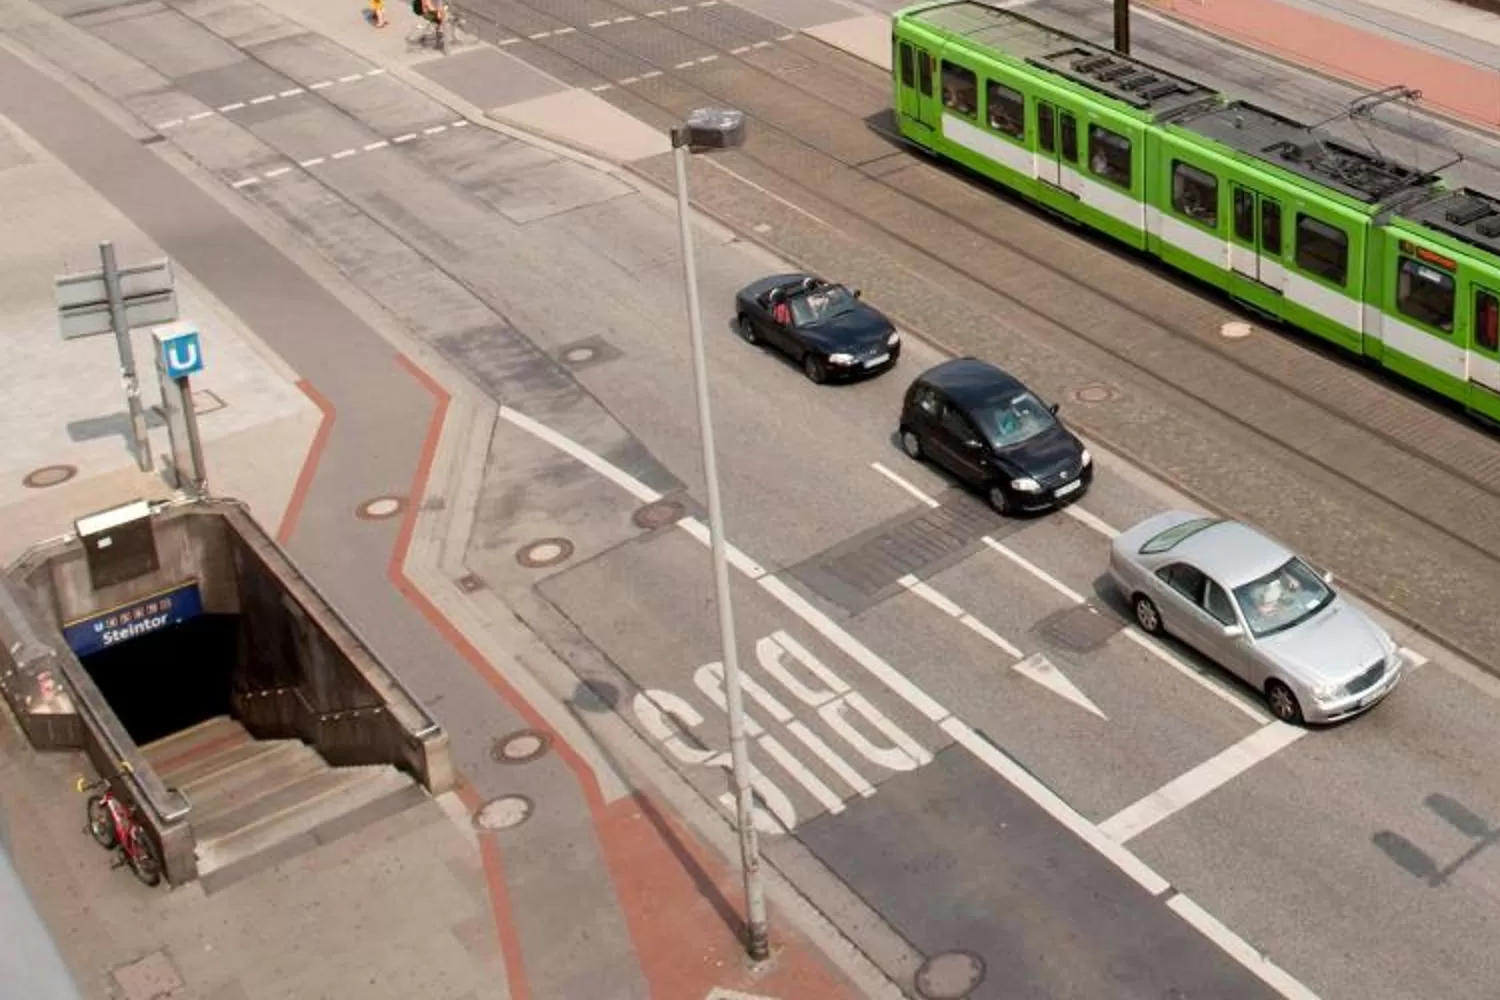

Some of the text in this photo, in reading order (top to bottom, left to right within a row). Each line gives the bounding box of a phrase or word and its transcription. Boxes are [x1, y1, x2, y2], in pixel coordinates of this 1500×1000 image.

[169, 343, 197, 370] U
[103, 613, 169, 646] Steintor
[633, 629, 934, 834] BUS
